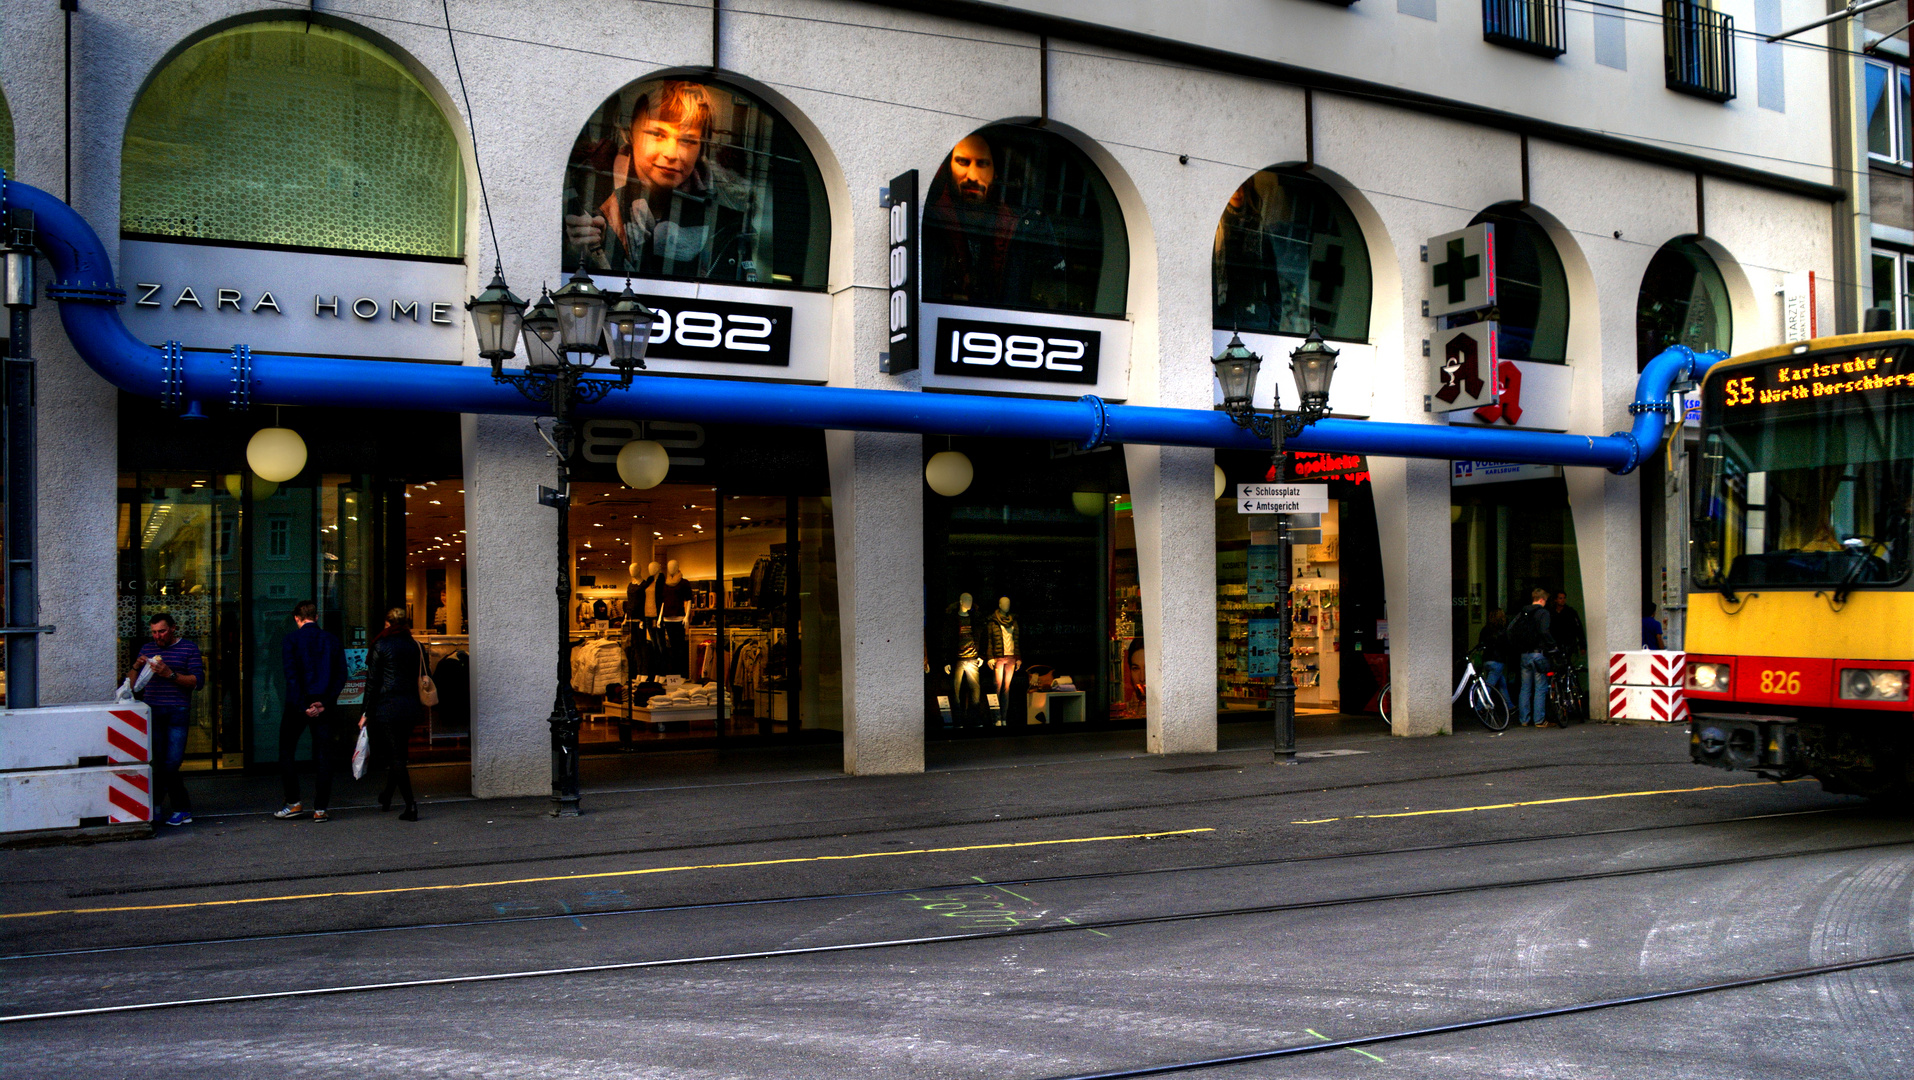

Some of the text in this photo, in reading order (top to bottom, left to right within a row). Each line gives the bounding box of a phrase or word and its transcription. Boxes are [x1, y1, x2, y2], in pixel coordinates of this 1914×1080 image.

[890, 201, 907, 343] 1982
[136, 282, 453, 323] ZARA HOME
[623, 308, 772, 352] 982
[951, 330, 1085, 372] 1982
[1778, 356, 1877, 383] Karlsruhe
[1725, 376, 1755, 407] S5
[1760, 384, 1809, 404] Wörth
[1295, 454, 1361, 477] apotheke
[1485, 467, 1520, 475] KARLSRUHE
[1255, 487, 1300, 498] Schlossplatz
[1256, 501, 1299, 512] Amtsgericht
[1760, 670, 1801, 694] 826
